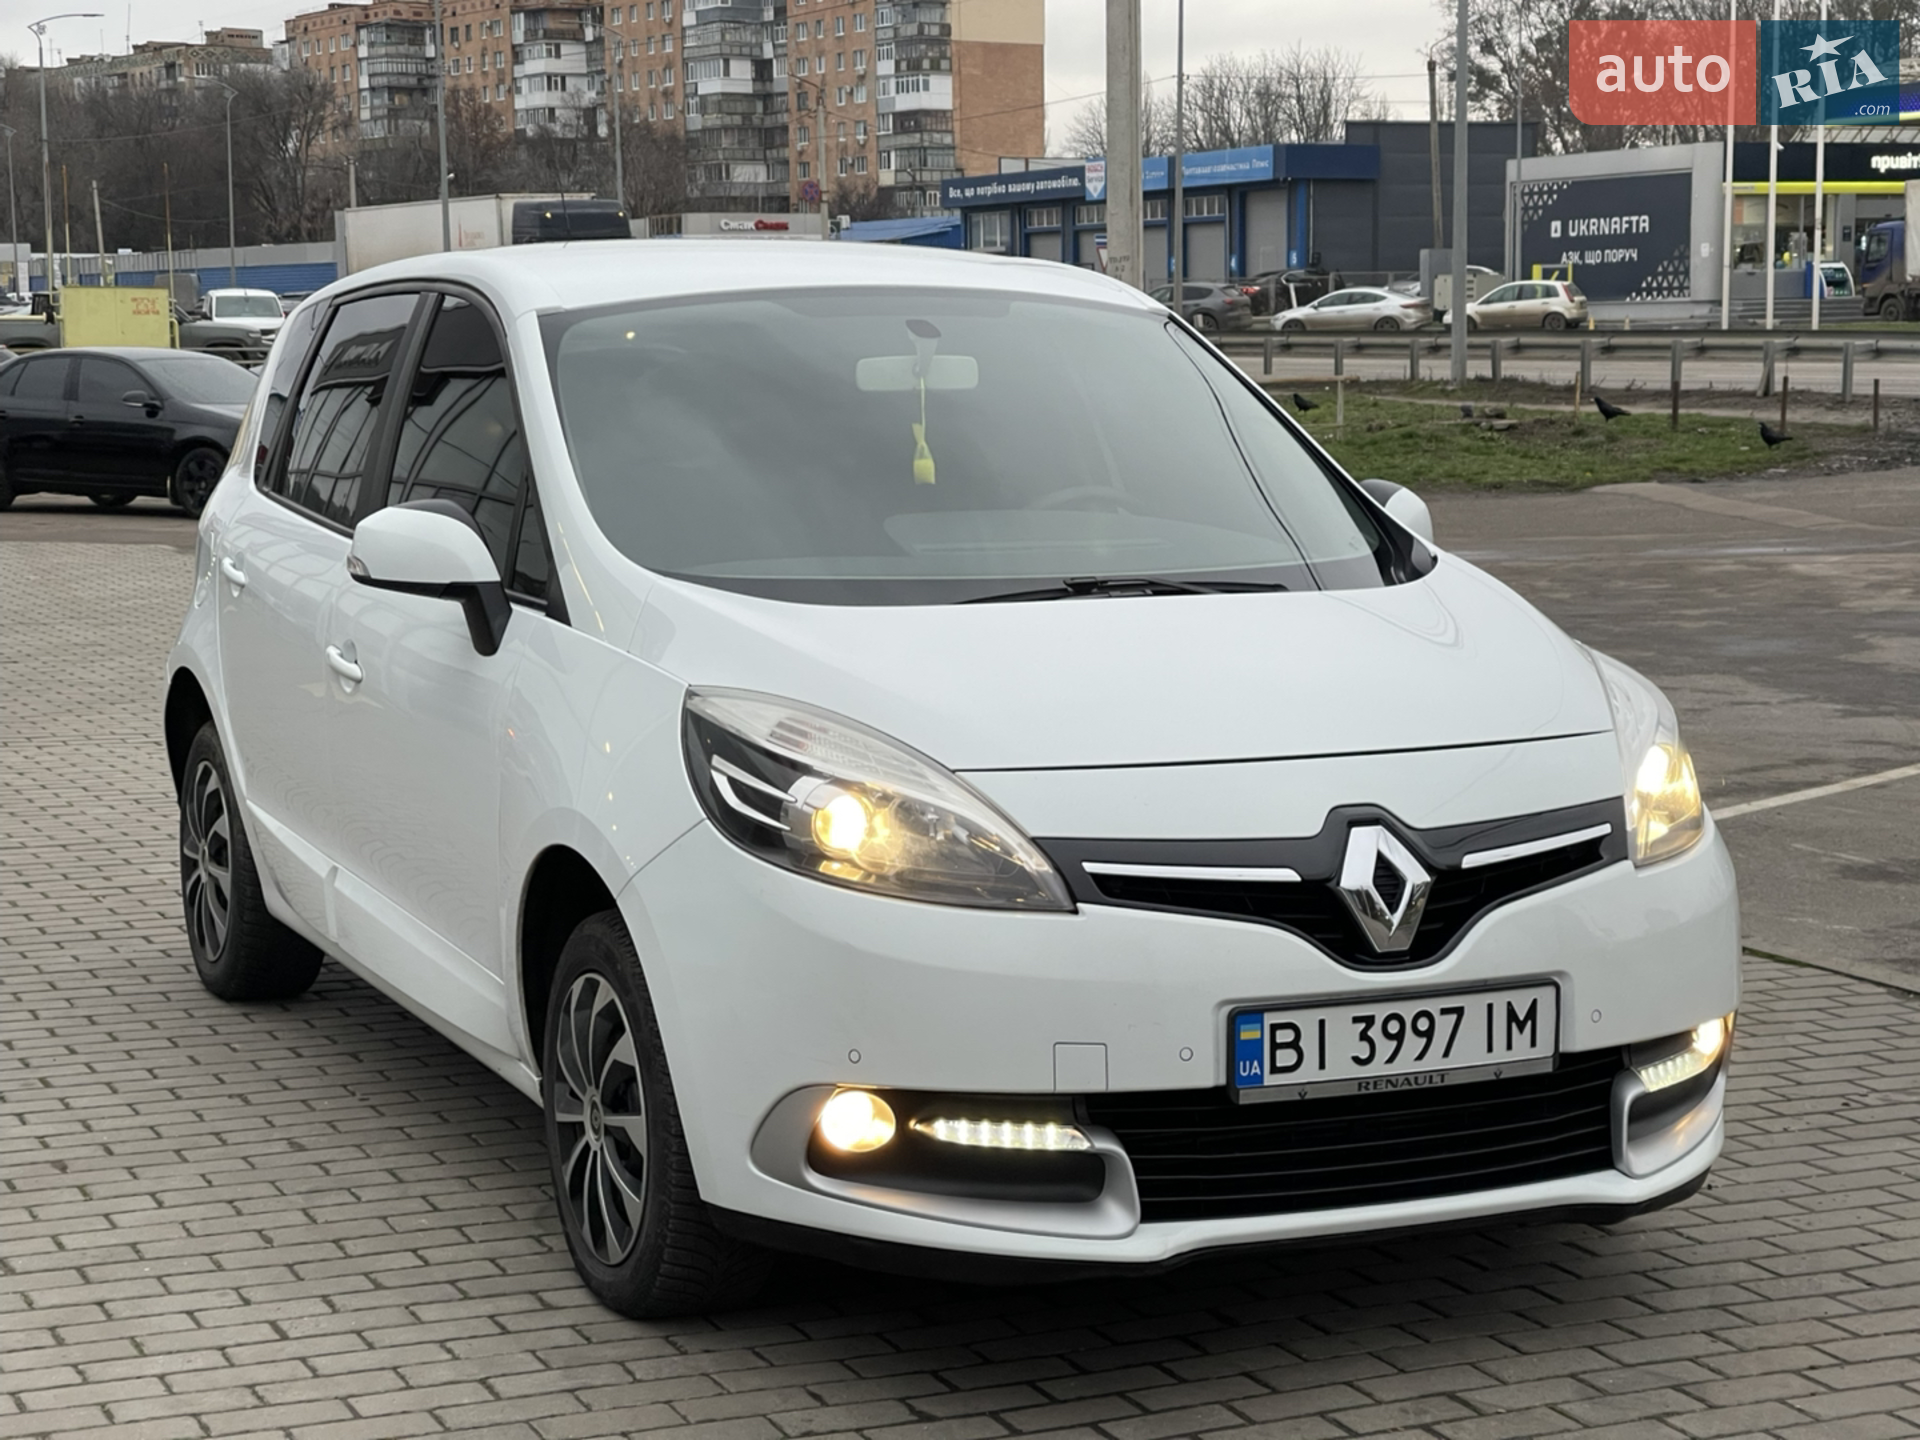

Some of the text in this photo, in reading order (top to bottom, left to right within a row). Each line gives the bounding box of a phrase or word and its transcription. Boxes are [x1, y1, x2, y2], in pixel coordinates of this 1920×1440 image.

[948, 176, 1081, 199] Все, що потрібно вашому автомобілю.
[1568, 214, 1650, 237] UKRNAFTA
[1560, 248, 1638, 266] АЗК, ЩО ПОРУЧ
[1268, 997, 1538, 1076] BI 3997 IM
[1239, 1059, 1261, 1077] UA
[1357, 1073, 1449, 1092] RENAULT
